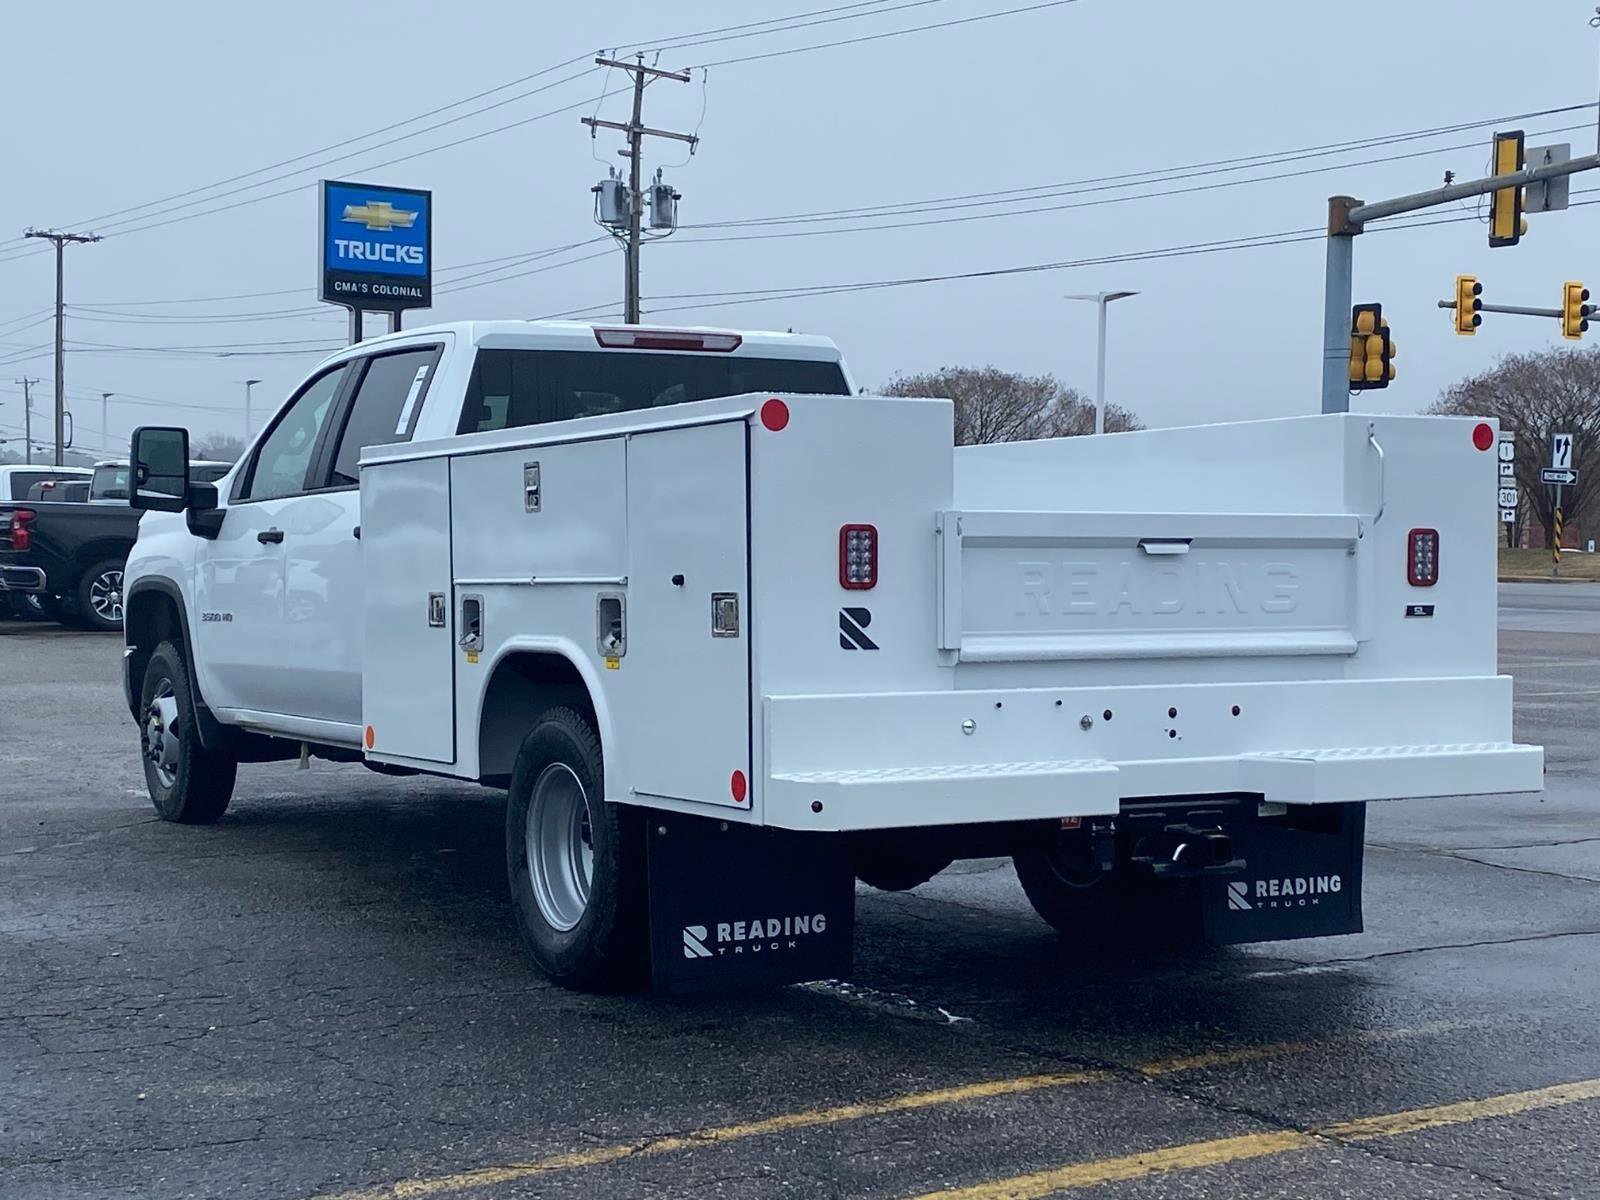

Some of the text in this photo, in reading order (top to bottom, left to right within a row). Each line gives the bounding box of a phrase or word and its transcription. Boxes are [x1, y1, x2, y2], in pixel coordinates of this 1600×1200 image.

[334, 239, 424, 265] TRUCKS
[334, 281, 423, 298] CMA'S COLONIAL
[1501, 492, 1516, 503] 301
[1015, 560, 1299, 615] READING
[1255, 875, 1341, 897] READING
[1257, 898, 1319, 908] TRUCK
[717, 914, 826, 942] READING
[718, 940, 796, 955] TRUCK
